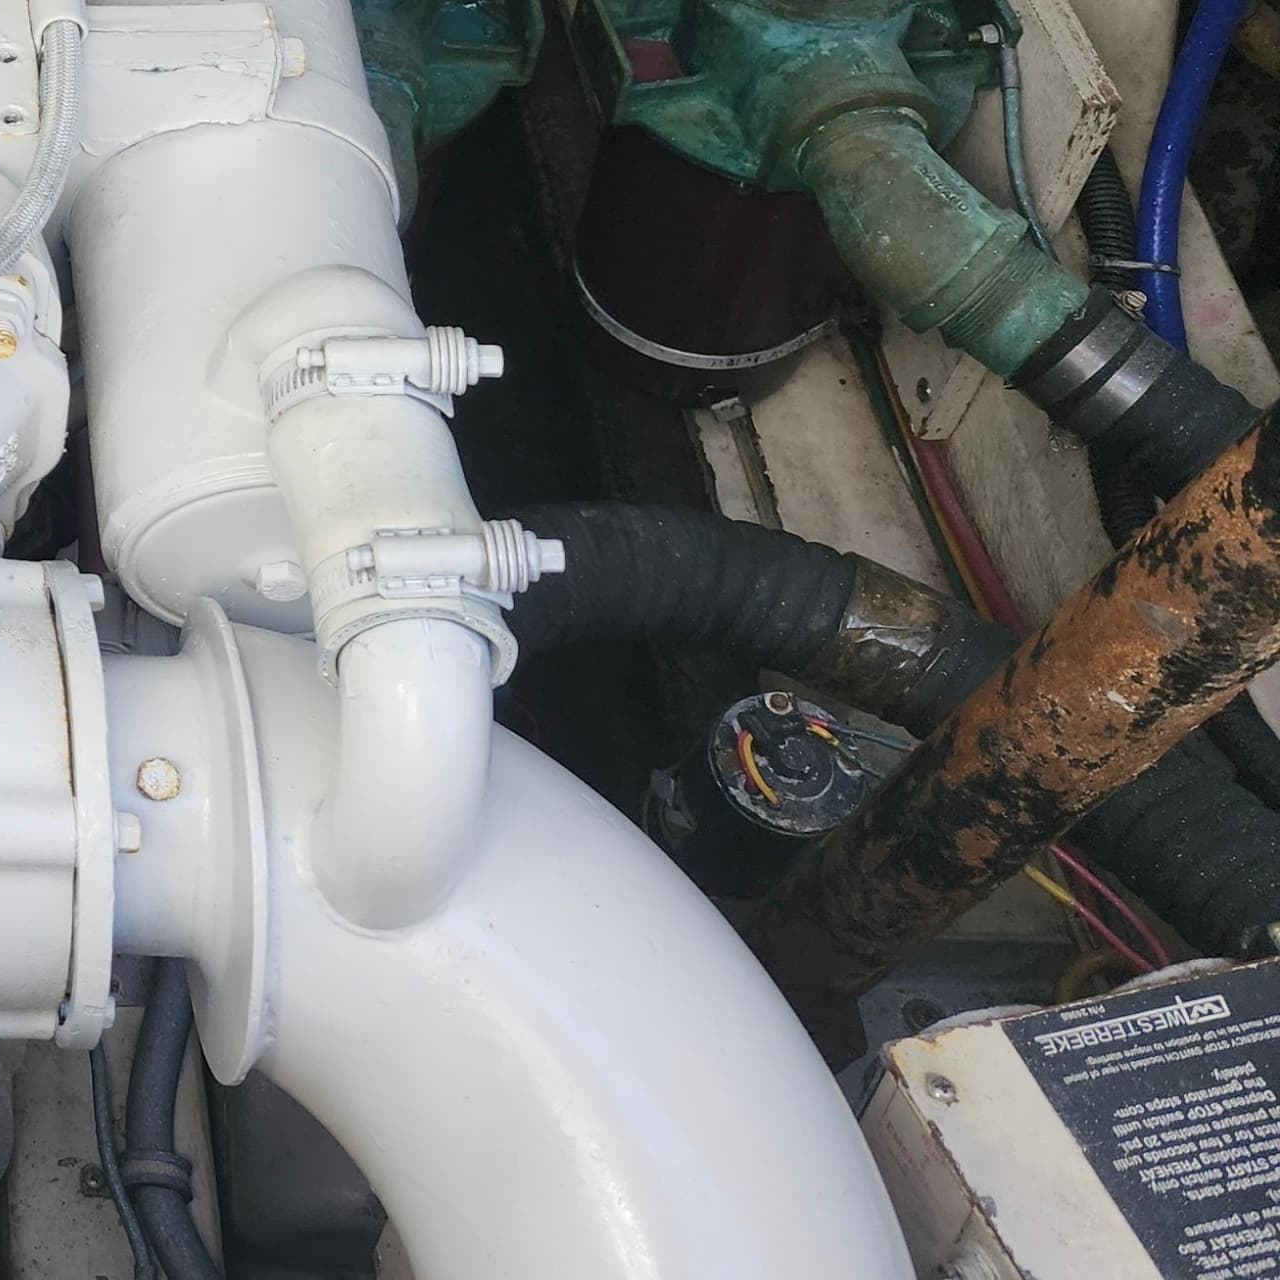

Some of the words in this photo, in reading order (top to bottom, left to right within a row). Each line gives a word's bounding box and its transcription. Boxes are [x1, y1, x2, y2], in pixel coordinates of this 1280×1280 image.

[1042, 1010, 1187, 1056] WESTERBEKE
[1183, 1078, 1243, 1103] generator
[1242, 1075, 1266, 1089] the
[1144, 1095, 1182, 1112] stops
[1221, 1089, 1276, 1109] Depress
[1142, 1110, 1184, 1129] switch
[1186, 1102, 1224, 1120] STOP
[1211, 1106, 1268, 1130] pressure
[1111, 1120, 1142, 1137] until
[1159, 1122, 1211, 1142] reaches
[1233, 1128, 1254, 1141] for
[1142, 1133, 1161, 1148] 20
[1198, 1136, 1222, 1150] few
[1142, 1141, 1197, 1163] seconds
[1198, 1145, 1250, 1165] holding
[1112, 1154, 1143, 1171] until
[1138, 1157, 1201, 1182] PREHEAT
[1225, 1157, 1269, 1177] START
[1179, 1167, 1223, 1186] switch
[1183, 1212, 1242, 1237] pressure
